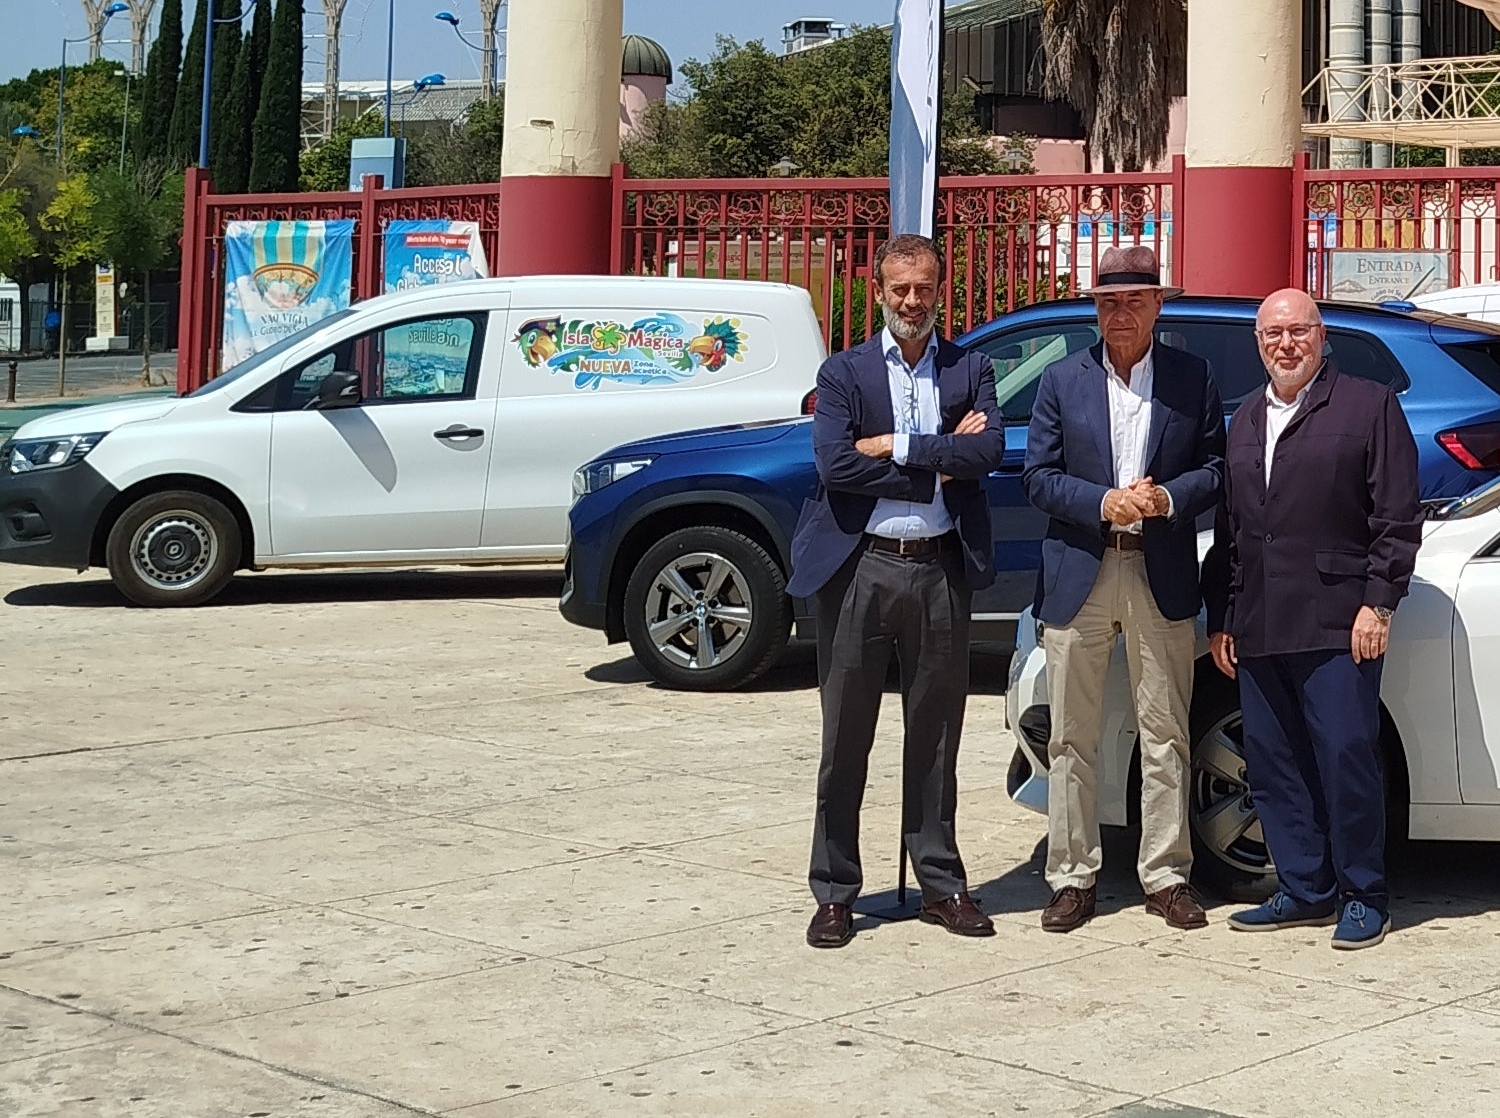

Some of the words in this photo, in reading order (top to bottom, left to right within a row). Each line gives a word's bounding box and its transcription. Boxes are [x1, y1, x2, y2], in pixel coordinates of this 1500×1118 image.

[1356, 257, 1423, 274] ENTRADA
[563, 329, 590, 346] Isla
[627, 329, 684, 351] Mágica
[657, 350, 684, 358] Sevilla
[579, 359, 632, 374] NUEVA
[633, 360, 654, 368] Zona
